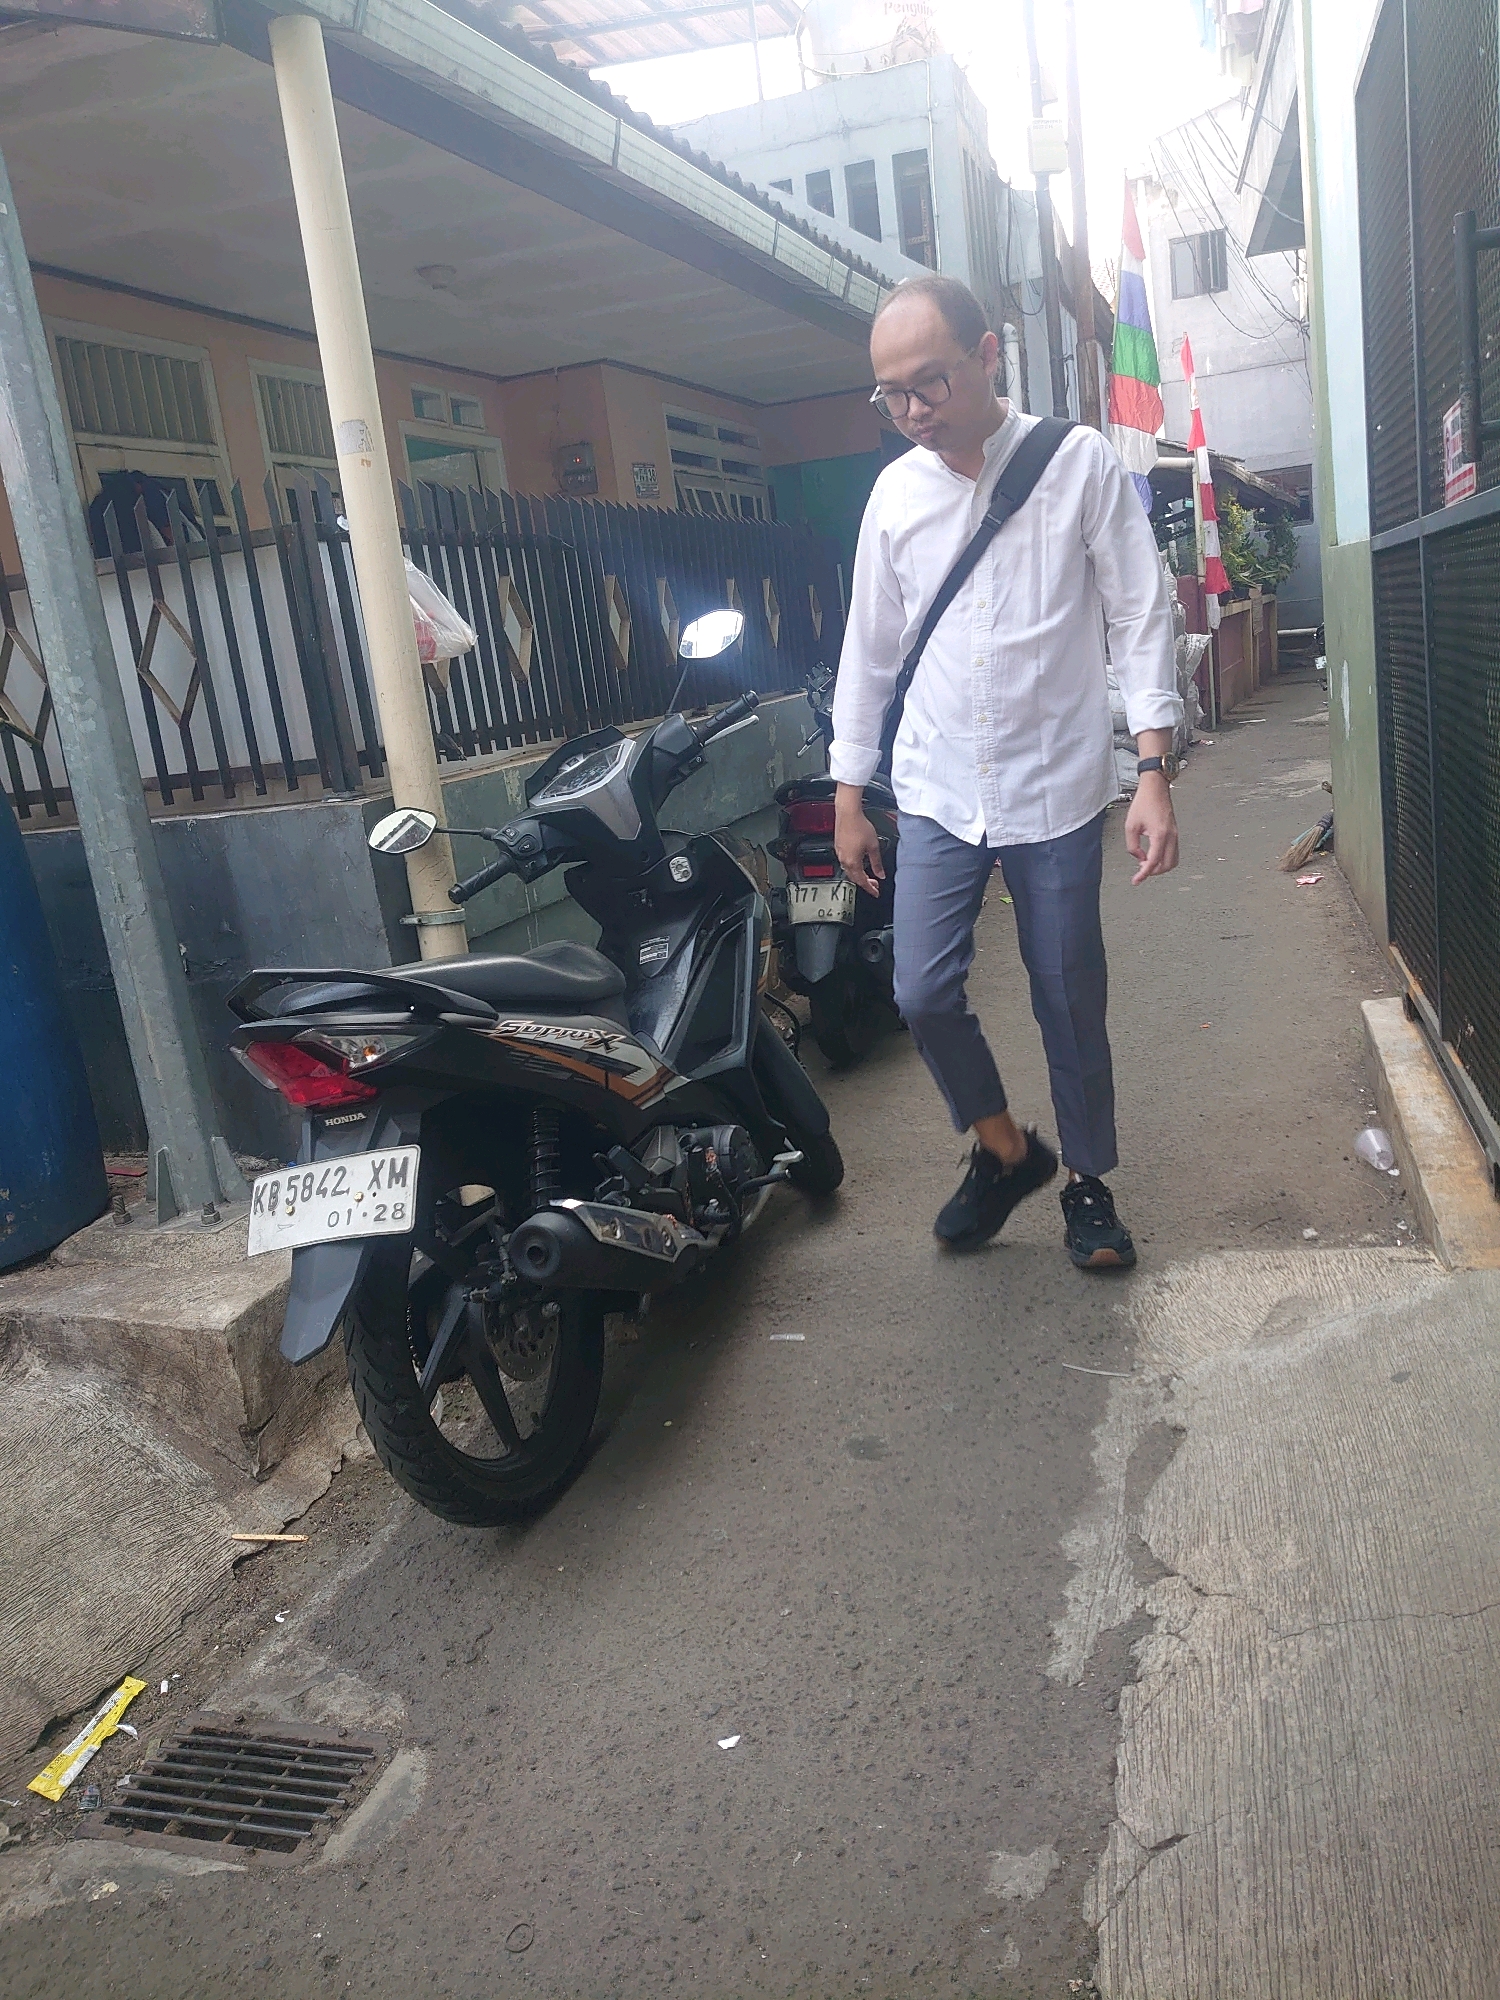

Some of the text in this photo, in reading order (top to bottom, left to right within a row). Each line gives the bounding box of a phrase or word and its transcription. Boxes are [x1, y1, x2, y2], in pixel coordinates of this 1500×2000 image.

[325, 1112, 367, 1127] HONDA
[253, 1155, 410, 1216] KB 5842 XM
